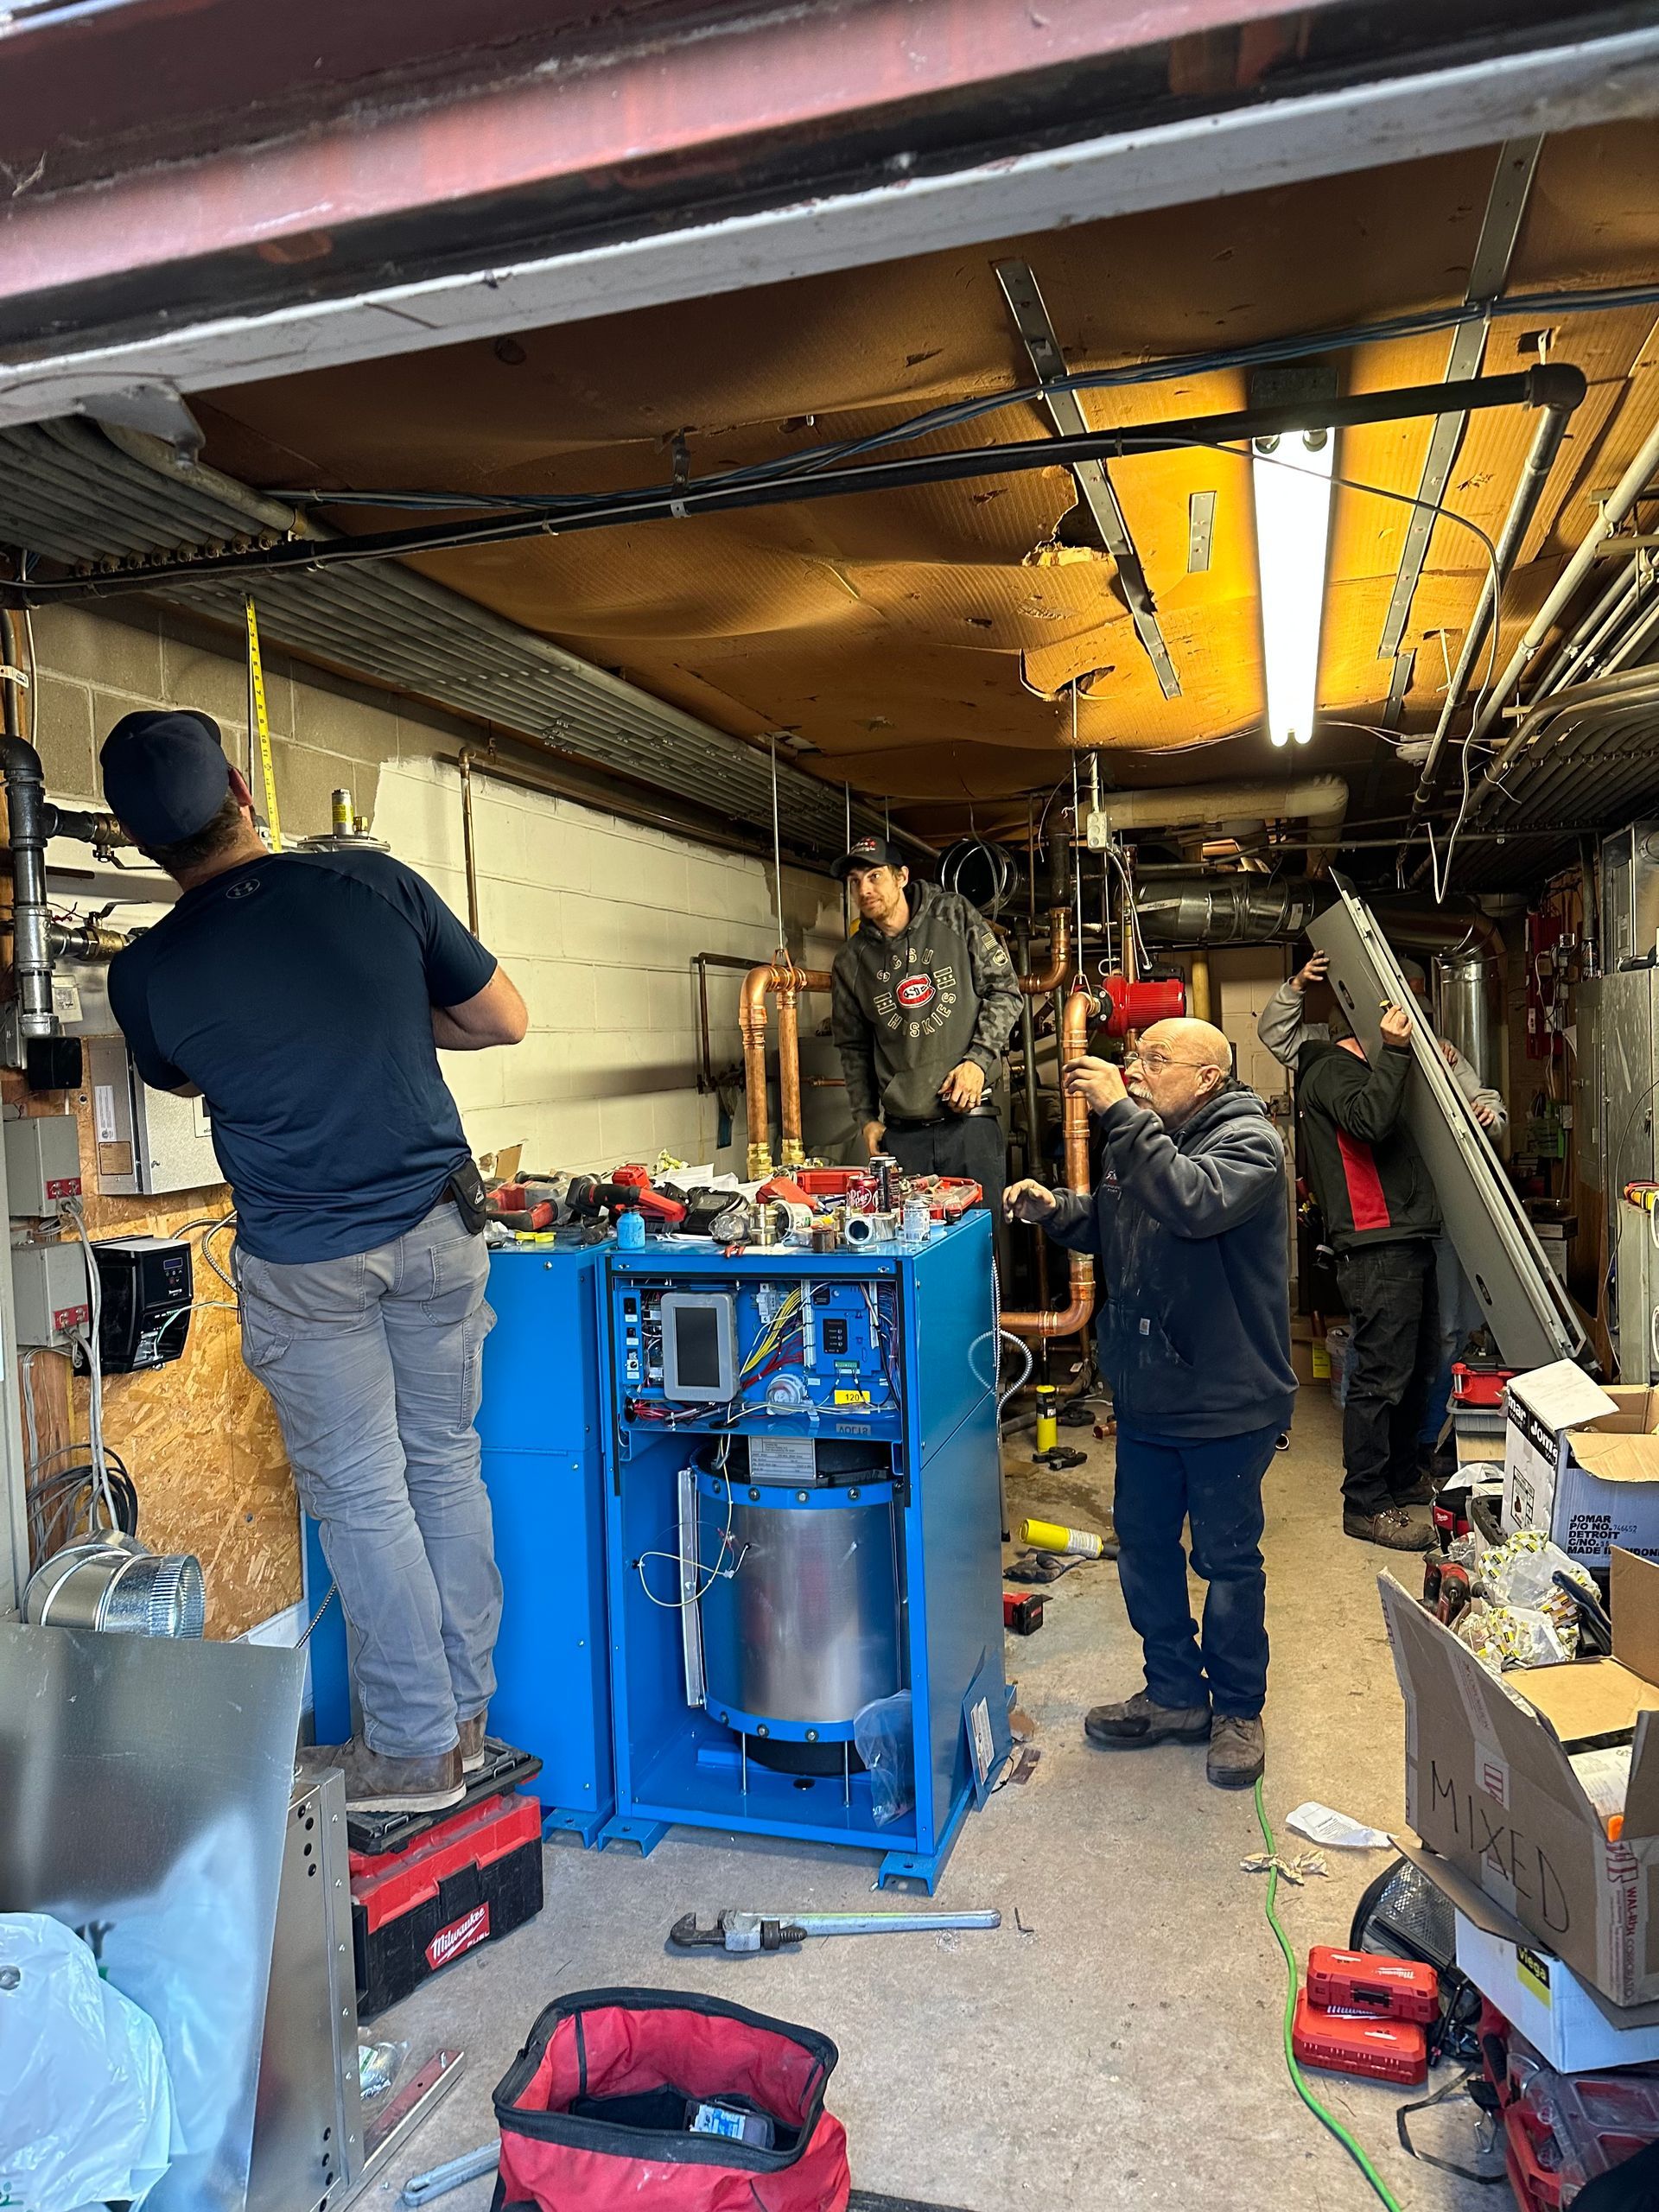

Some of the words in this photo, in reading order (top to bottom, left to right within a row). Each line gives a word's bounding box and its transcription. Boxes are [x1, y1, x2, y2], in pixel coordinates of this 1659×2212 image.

[887, 992, 957, 1038] HSKIES
[845, 1393, 860, 1402] 120
[1507, 1389, 1527, 1421] mar
[1570, 1515, 1611, 1523] JOMAR
[1568, 1530, 1620, 1539] DETROIT
[1568, 1538, 1599, 1547] C/NO.
[1567, 1546, 1600, 1554] MADE
[1431, 1760, 1569, 1933] MIXED
[430, 1907, 486, 1961] Milwaukee
[467, 1930, 490, 1948] FUEL
[1517, 1947, 1547, 1981] viega
